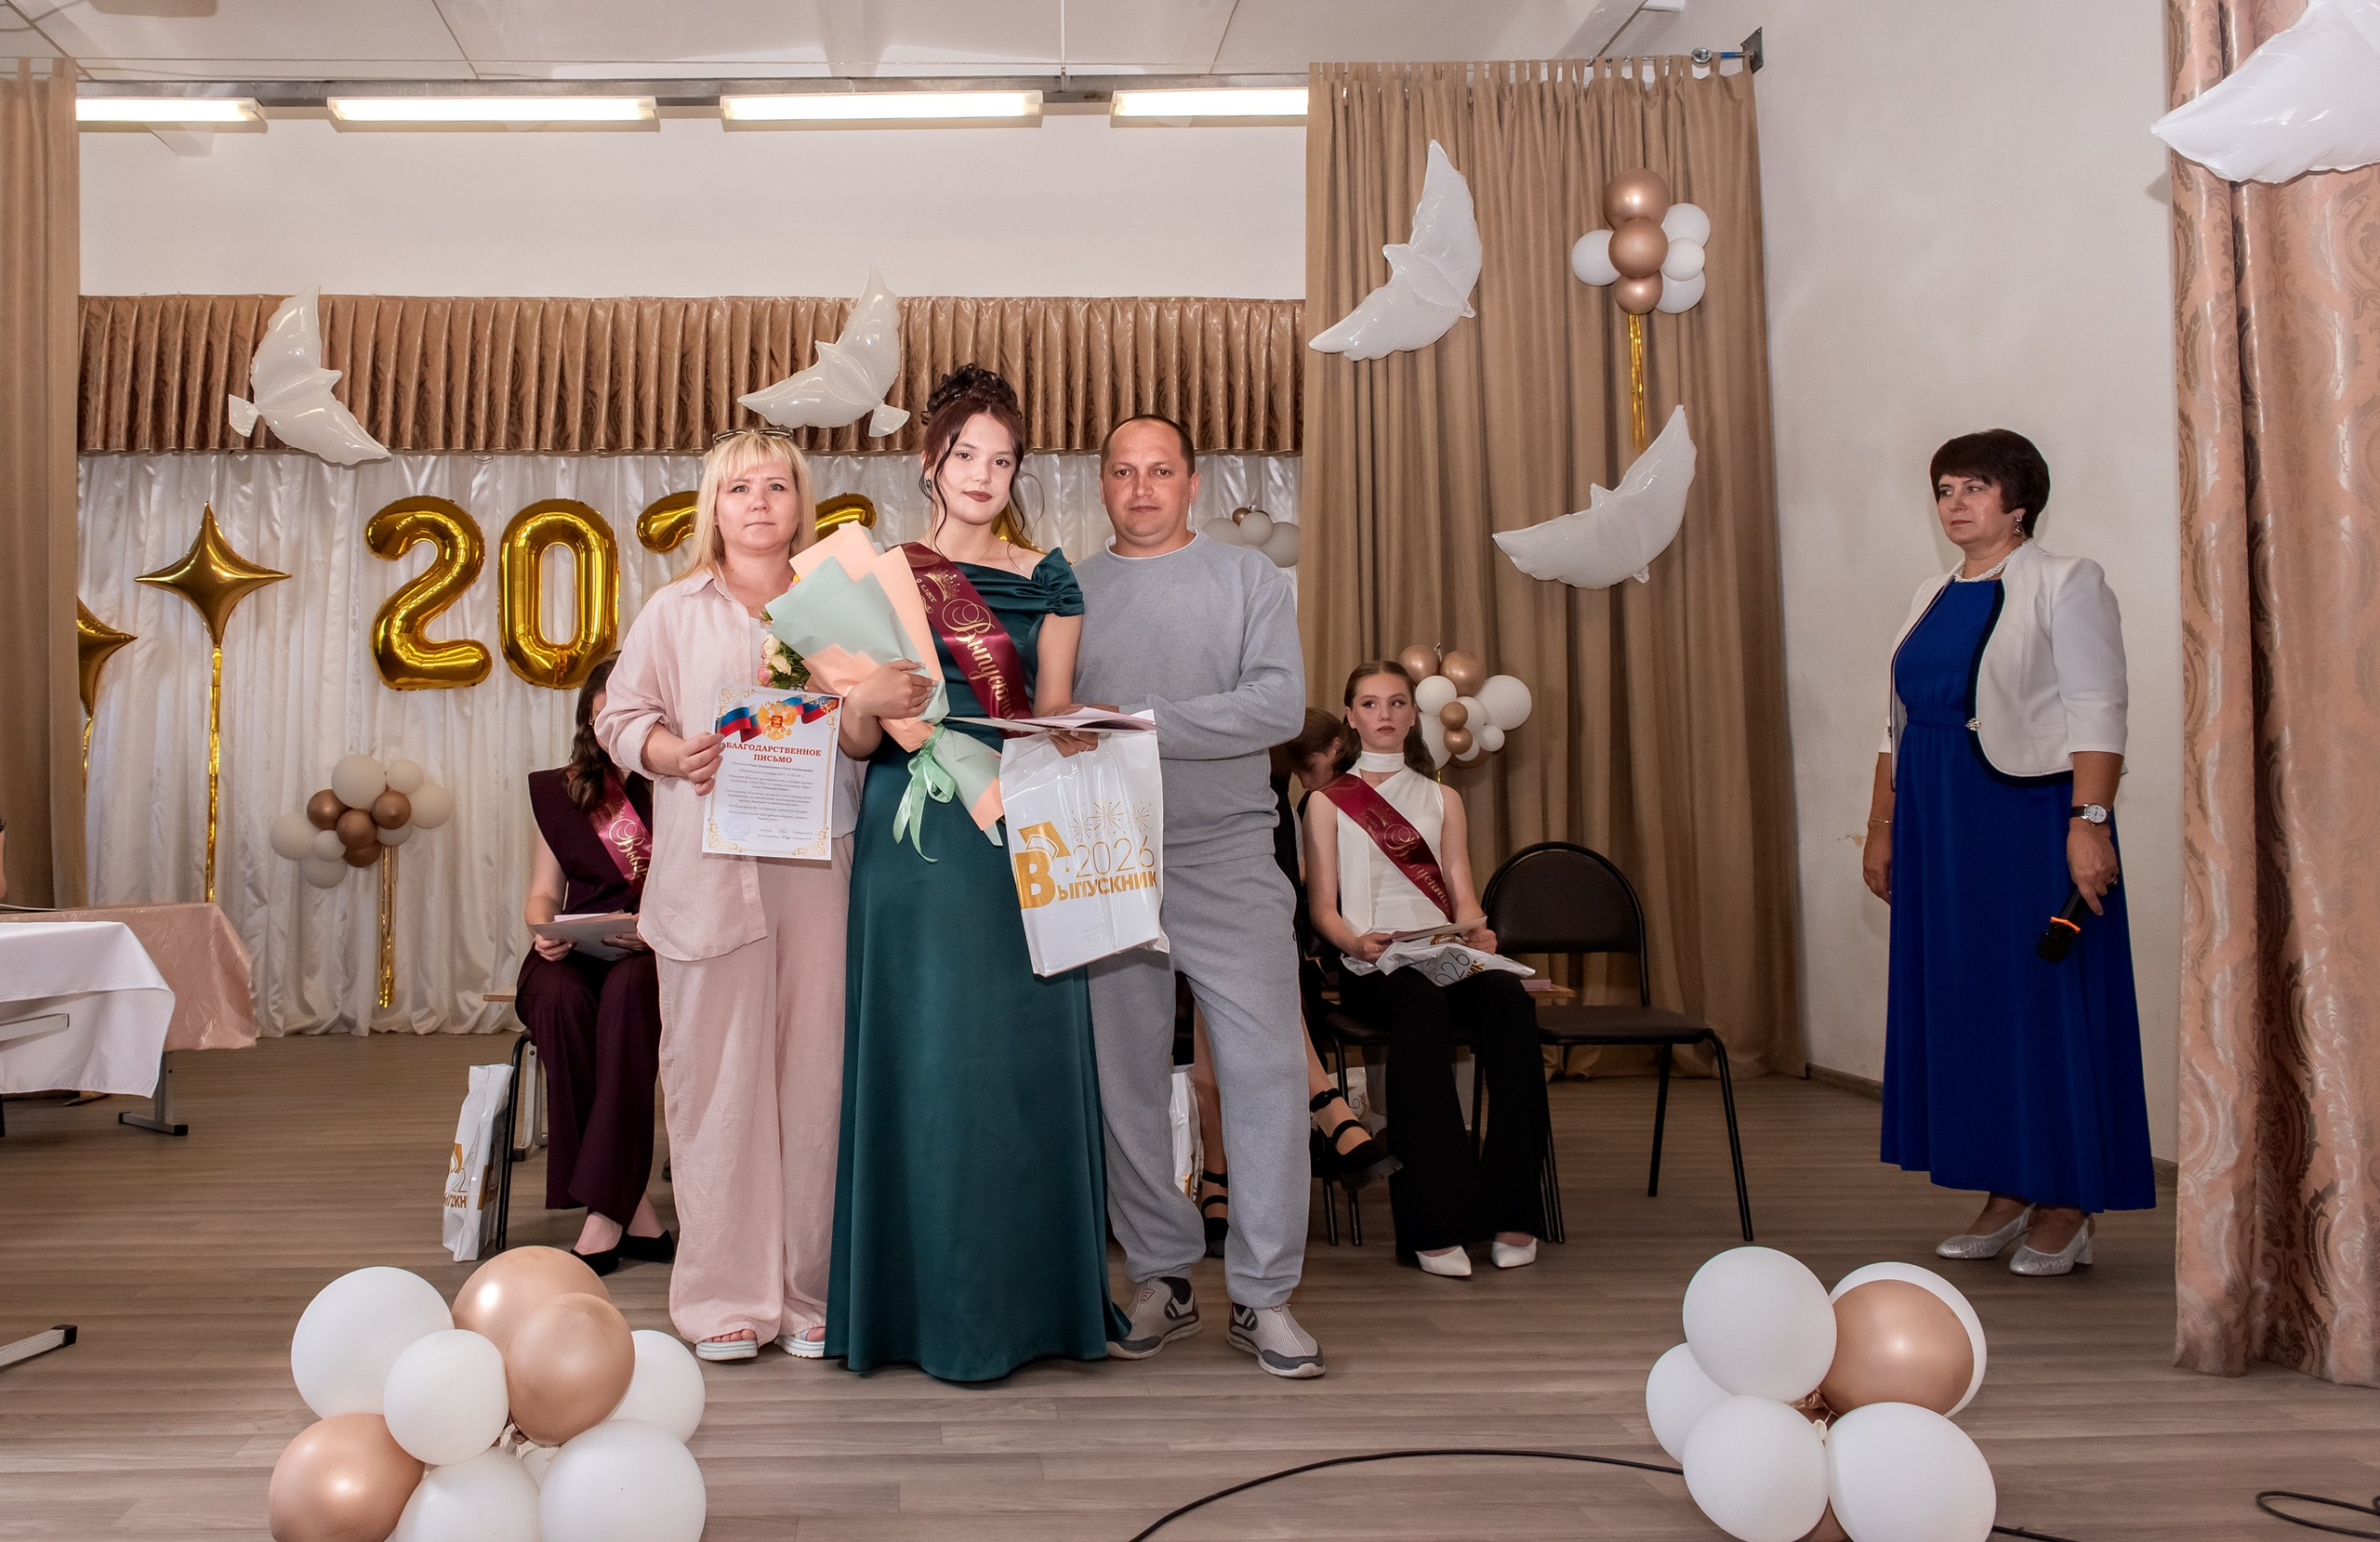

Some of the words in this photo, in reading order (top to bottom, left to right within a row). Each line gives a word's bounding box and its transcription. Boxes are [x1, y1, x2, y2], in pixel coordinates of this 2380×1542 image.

[725, 742, 822, 757] БЛАГОДАРСТВЕННОЕ
[754, 754, 792, 763] ПИСЬМО
[1073, 836, 1155, 878] 2026
